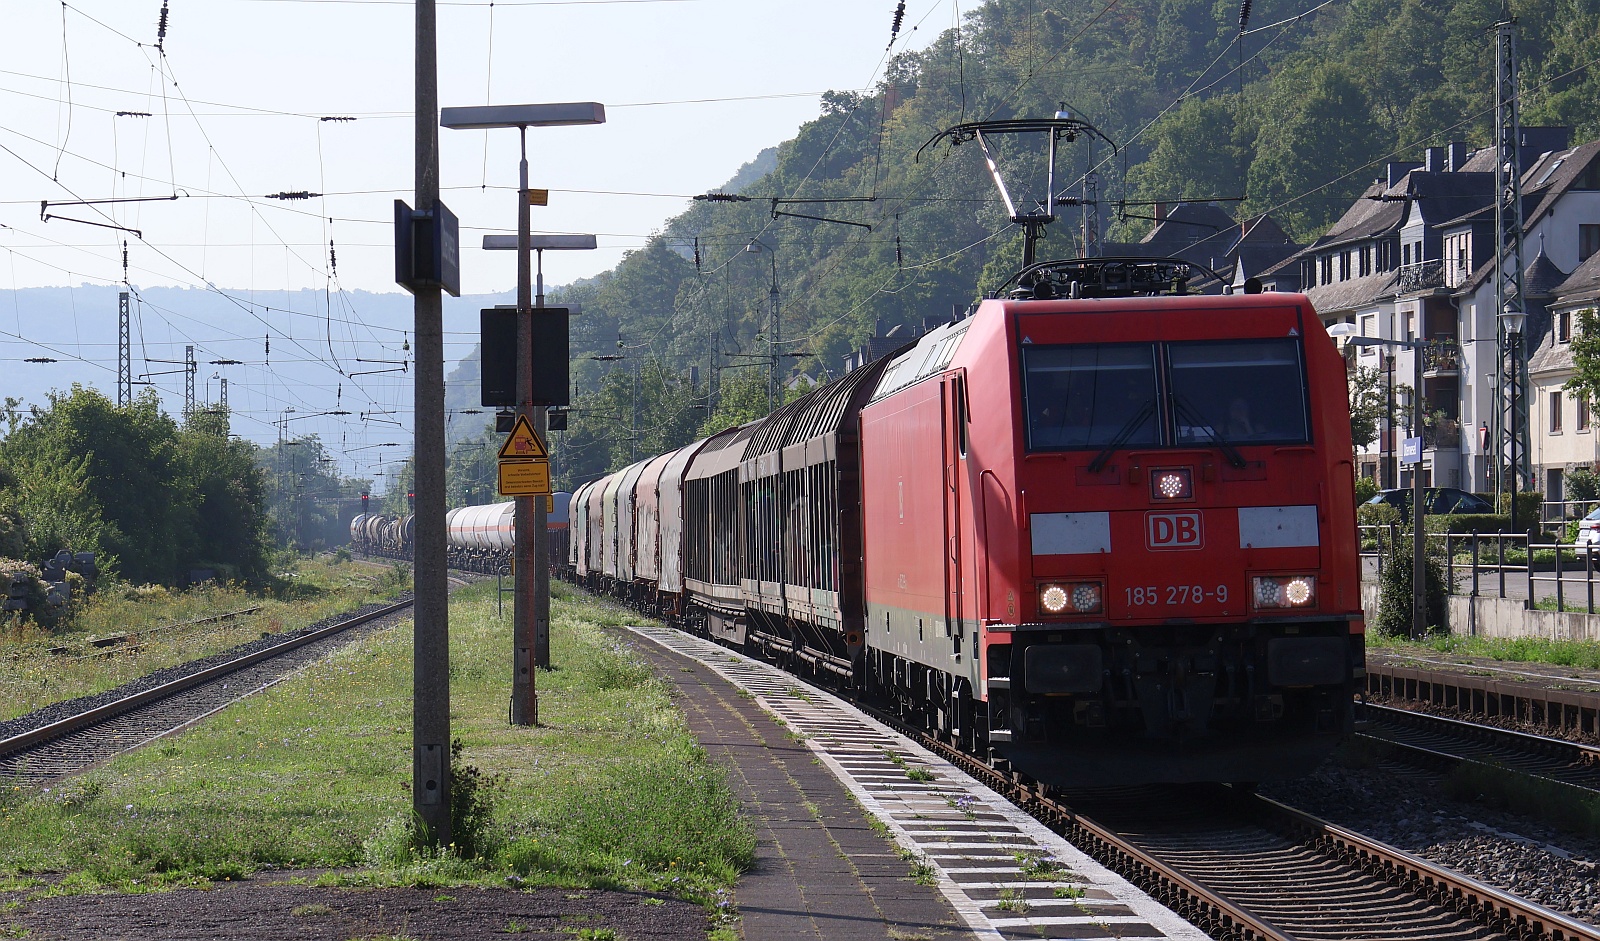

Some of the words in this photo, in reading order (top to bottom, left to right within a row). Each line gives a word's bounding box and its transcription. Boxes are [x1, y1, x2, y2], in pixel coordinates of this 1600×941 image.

[1152, 516, 1197, 544] DB
[1125, 586, 1158, 605] 185
[1166, 584, 1228, 605] 278-9
